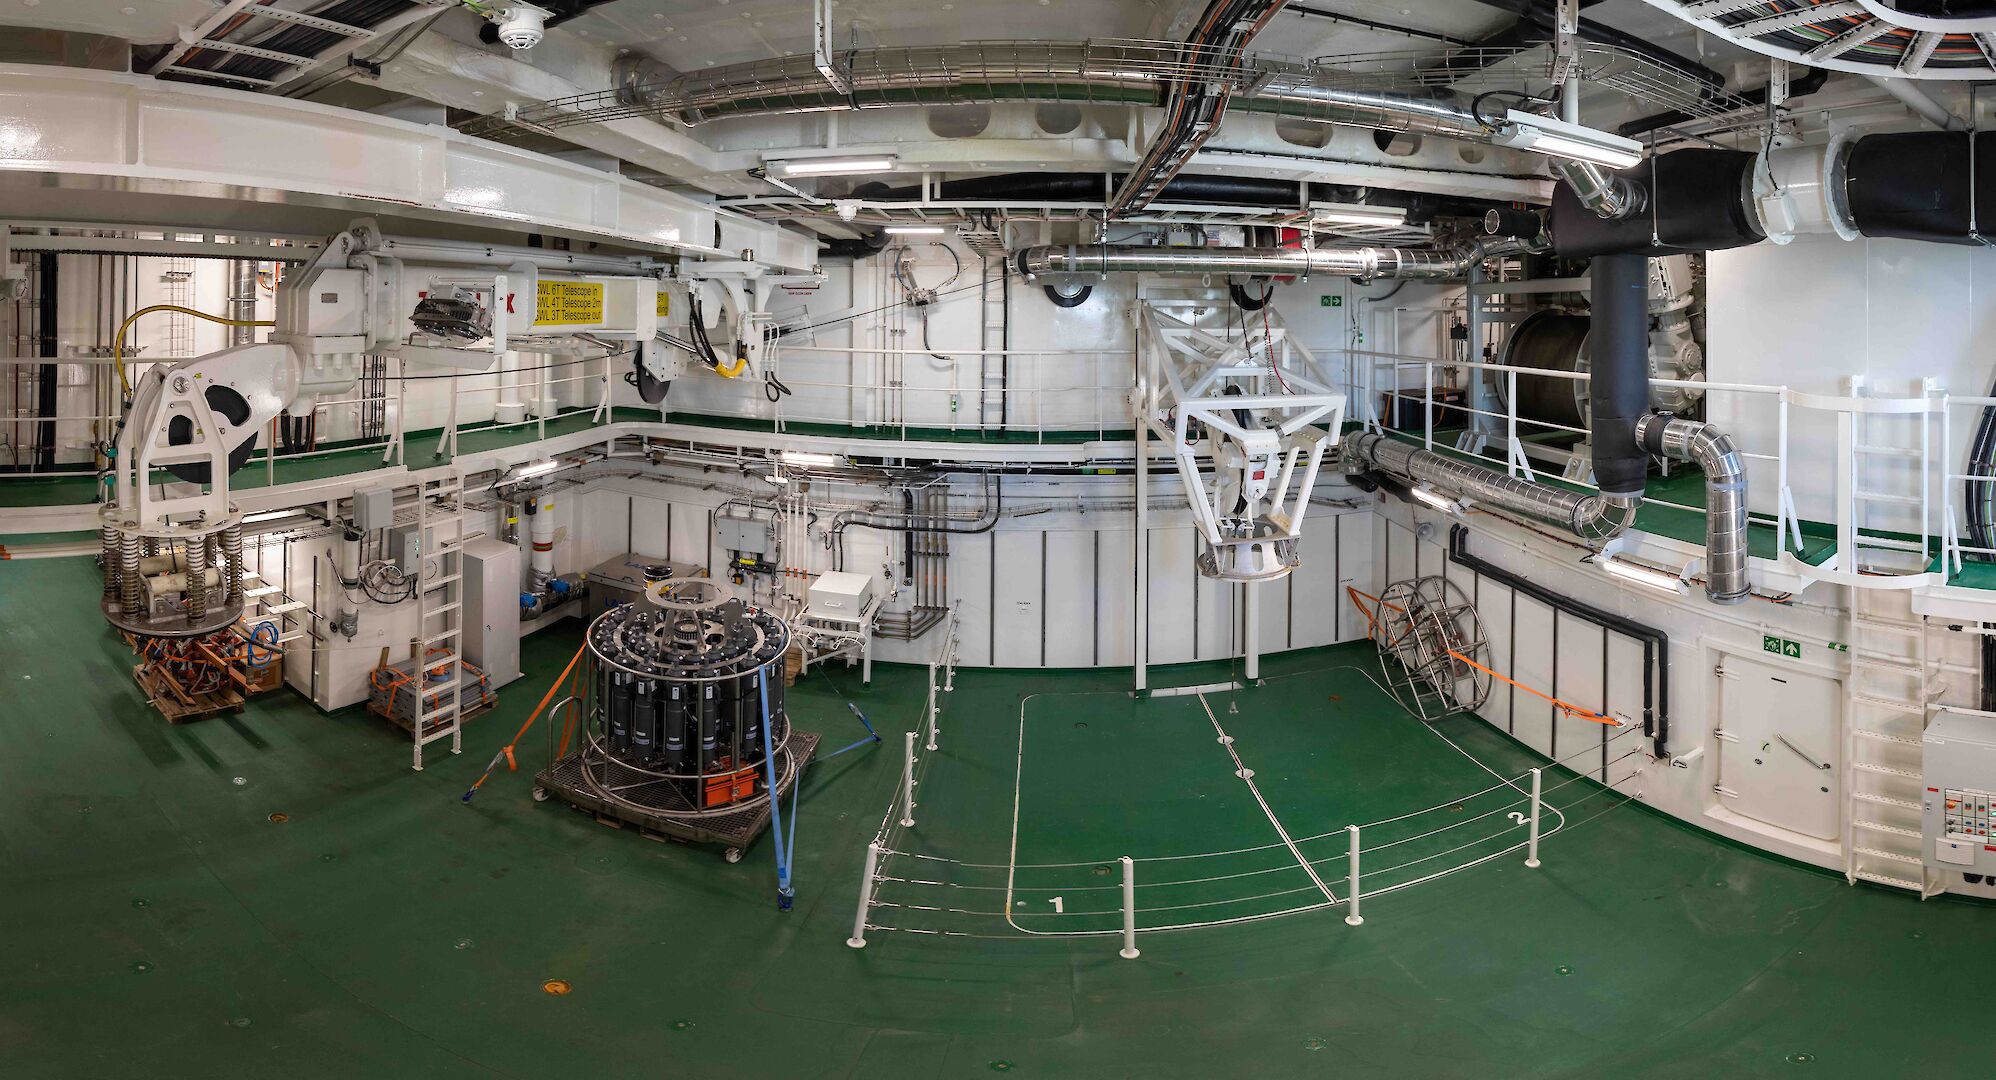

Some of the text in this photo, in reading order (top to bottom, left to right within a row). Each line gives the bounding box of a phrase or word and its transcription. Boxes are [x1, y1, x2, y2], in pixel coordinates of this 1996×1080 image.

[551, 284, 561, 295] 6T
[561, 283, 592, 298] Telescope
[551, 296, 560, 308] 4T
[561, 296, 592, 311] Telescope
[551, 309, 560, 321] 3T
[561, 309, 592, 323] Telescope
[1507, 811, 1532, 825] 2
[1048, 896, 1063, 913] 1
